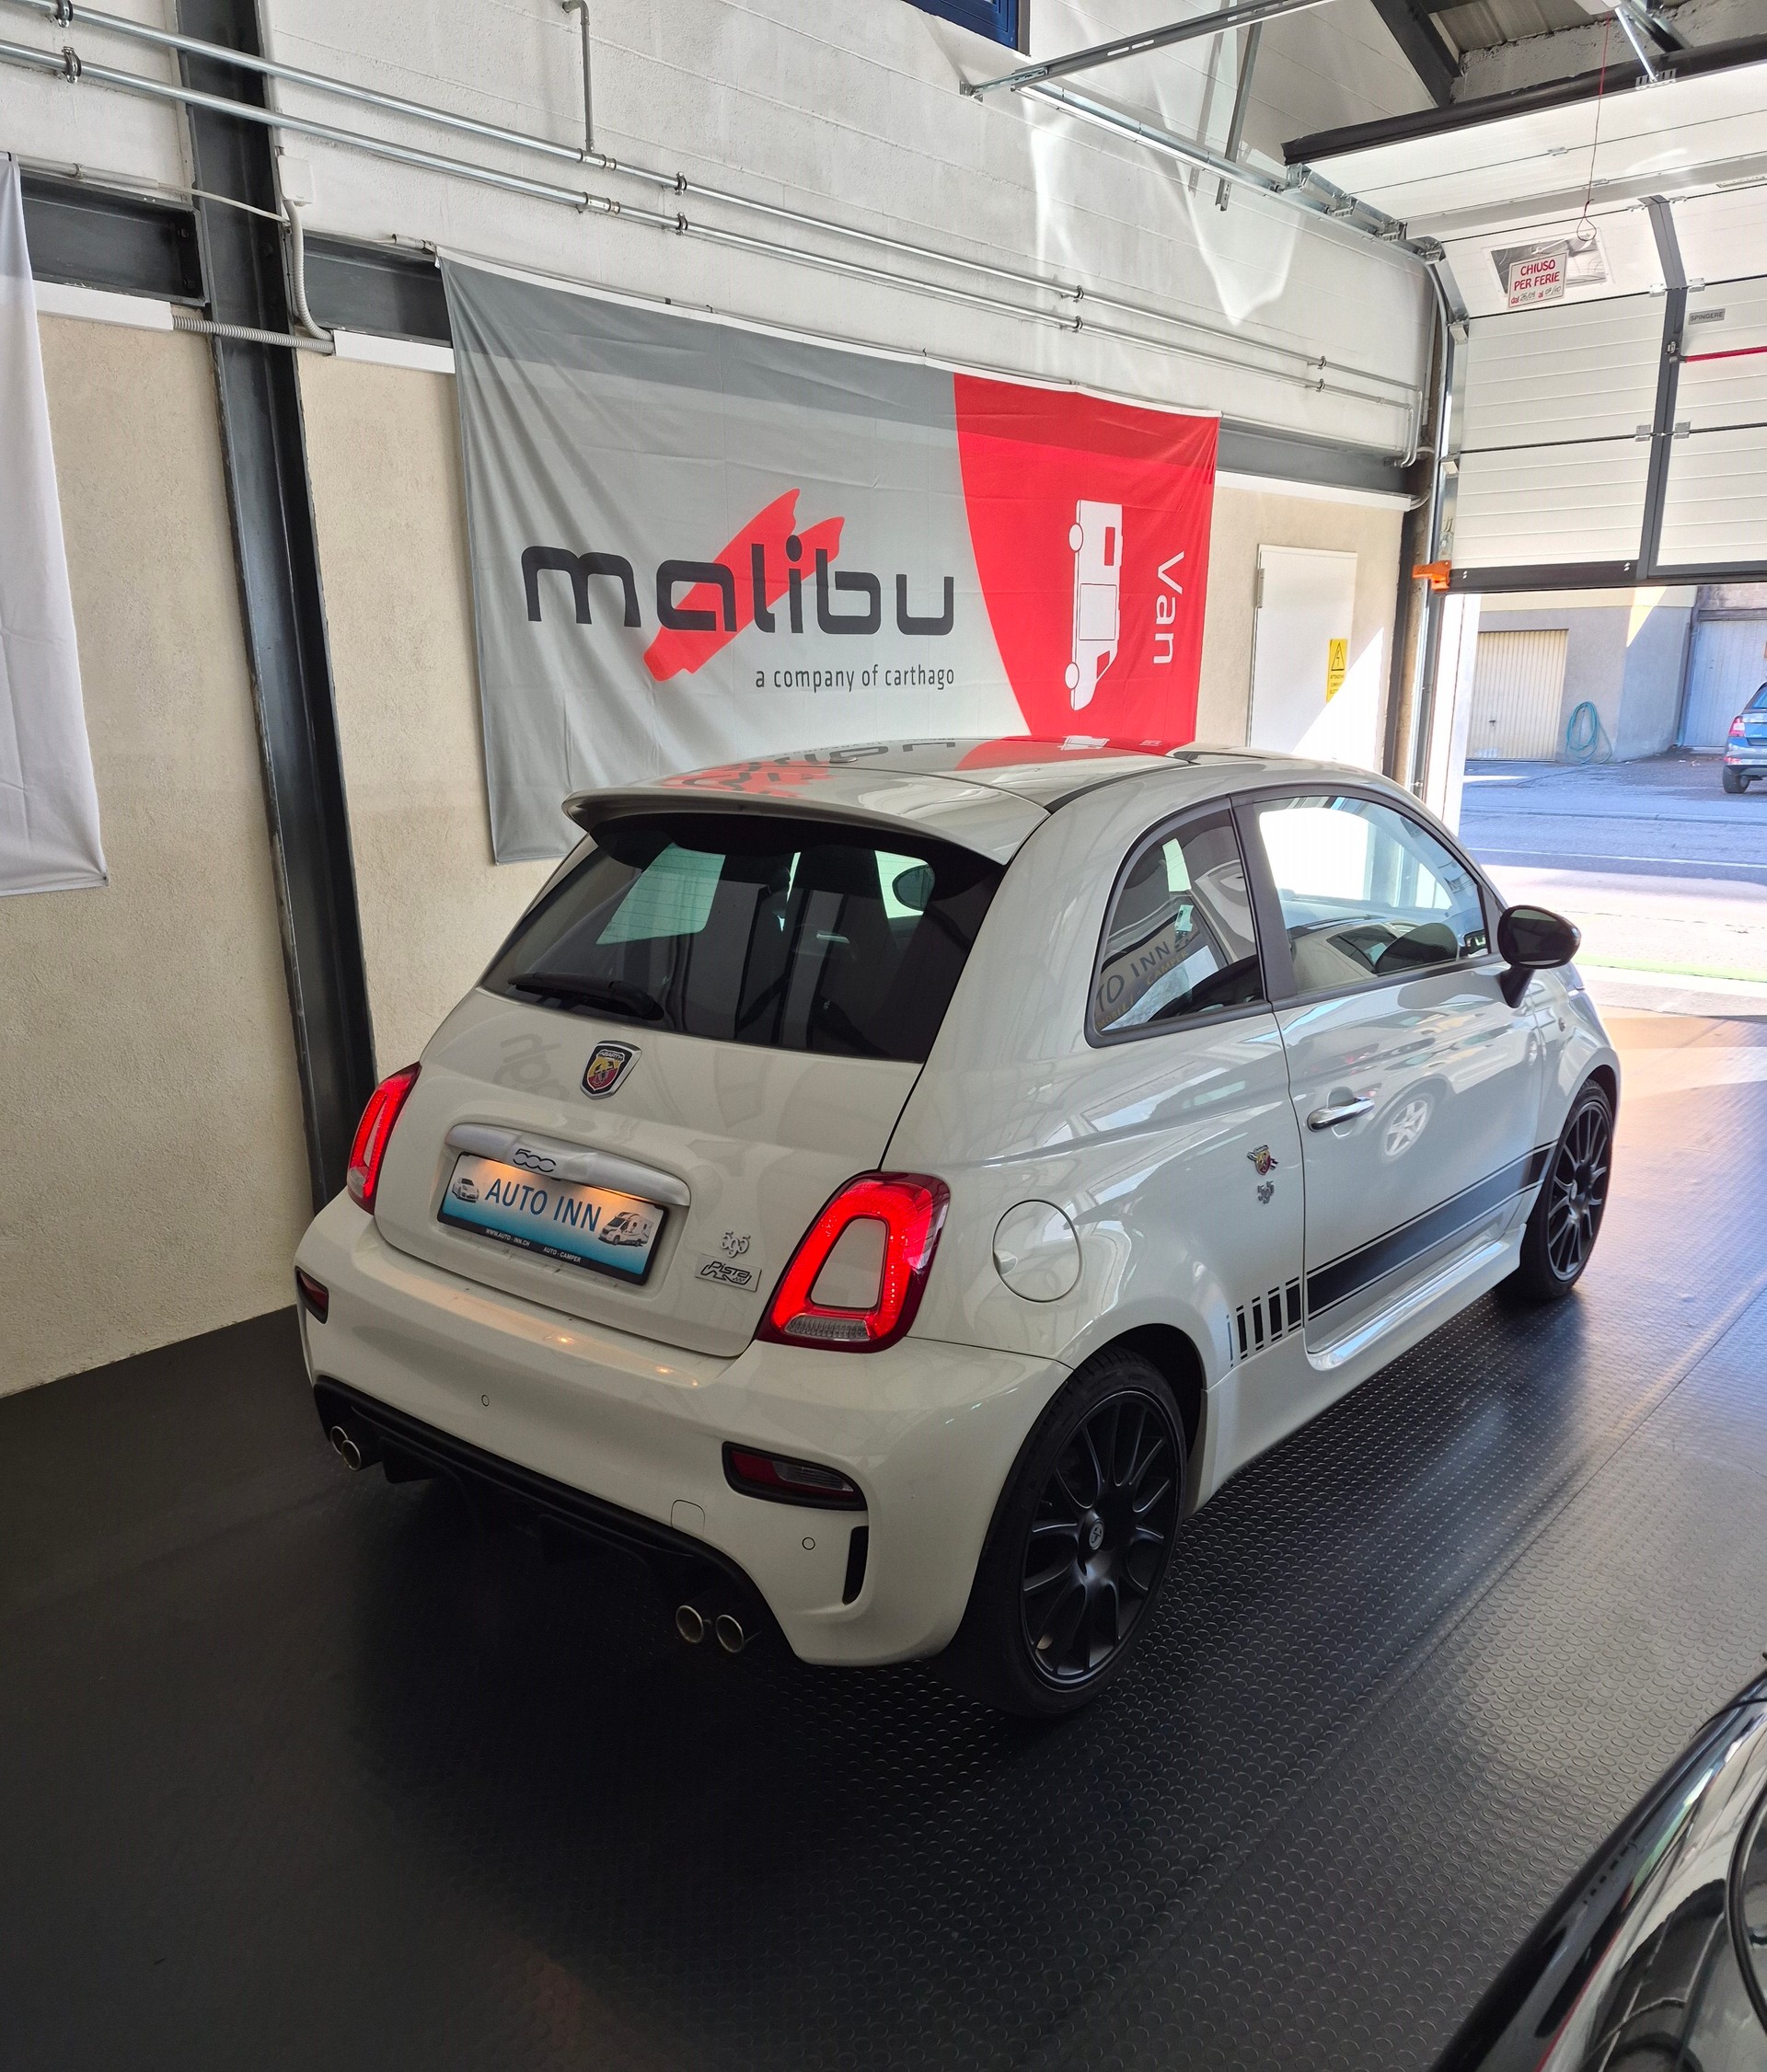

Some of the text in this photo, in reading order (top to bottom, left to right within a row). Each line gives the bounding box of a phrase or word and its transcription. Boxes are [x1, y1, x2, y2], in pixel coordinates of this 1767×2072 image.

[1520, 259, 1555, 276] CHIUSO
[1514, 271, 1560, 291] PER FERIE
[1538, 290, 1543, 298] al
[1690, 311, 1723, 321] SPINGERE
[521, 535, 954, 636] malibu
[1153, 550, 1184, 663] Van
[756, 664, 954, 693] a company of carthago
[599, 1051, 623, 1060] ABARTH
[513, 1148, 556, 1172] 500
[484, 1178, 602, 1232] AUTO INN
[543, 1247, 557, 1256] AUTO
[560, 1251, 582, 1263] CAMPER
[721, 1231, 751, 1259] 595
